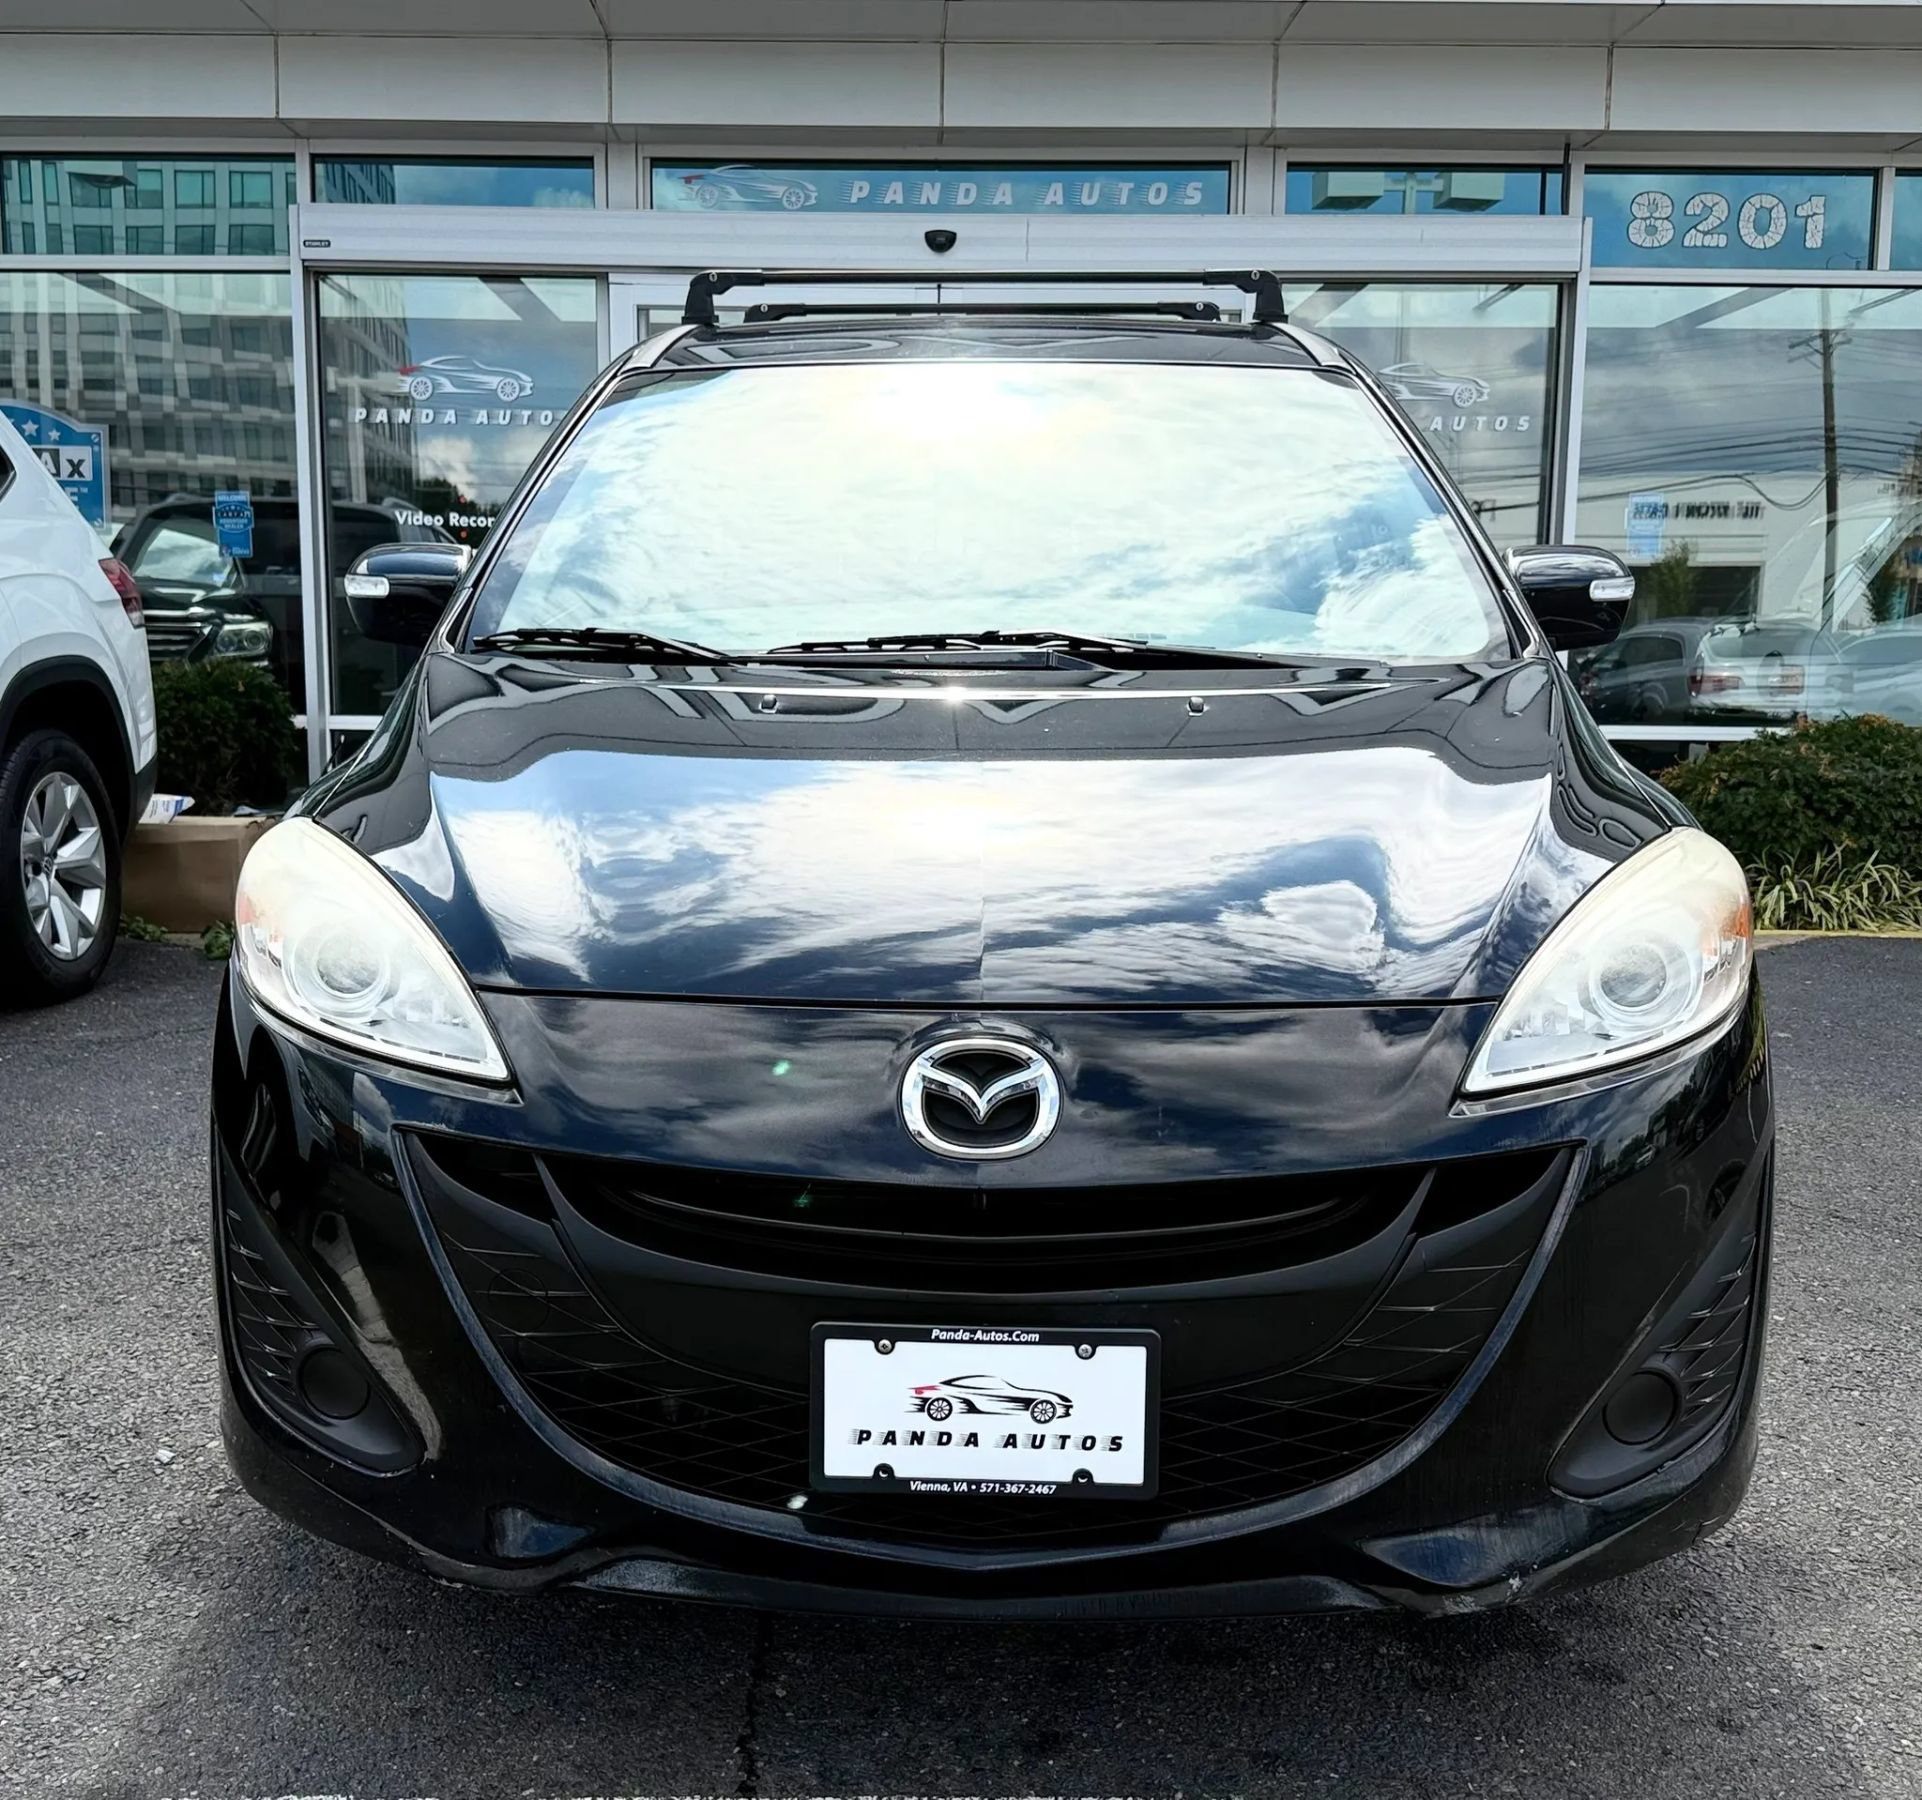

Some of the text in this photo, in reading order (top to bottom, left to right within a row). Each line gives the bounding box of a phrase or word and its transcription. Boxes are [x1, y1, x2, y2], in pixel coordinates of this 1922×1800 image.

[846, 180, 1204, 207] PANDA AUTOS
[1627, 190, 1827, 249] 8201
[353, 407, 555, 427] PANDA AUTO
[1429, 415, 1531, 432] AUTOS
[394, 510, 497, 527] Video Recor
[930, 1328, 1040, 1342] Panda-Autos.Com
[852, 1429, 1124, 1452] PANDA AUTOS
[909, 1480, 1057, 1495] Vienna, VA 571-367-2467
